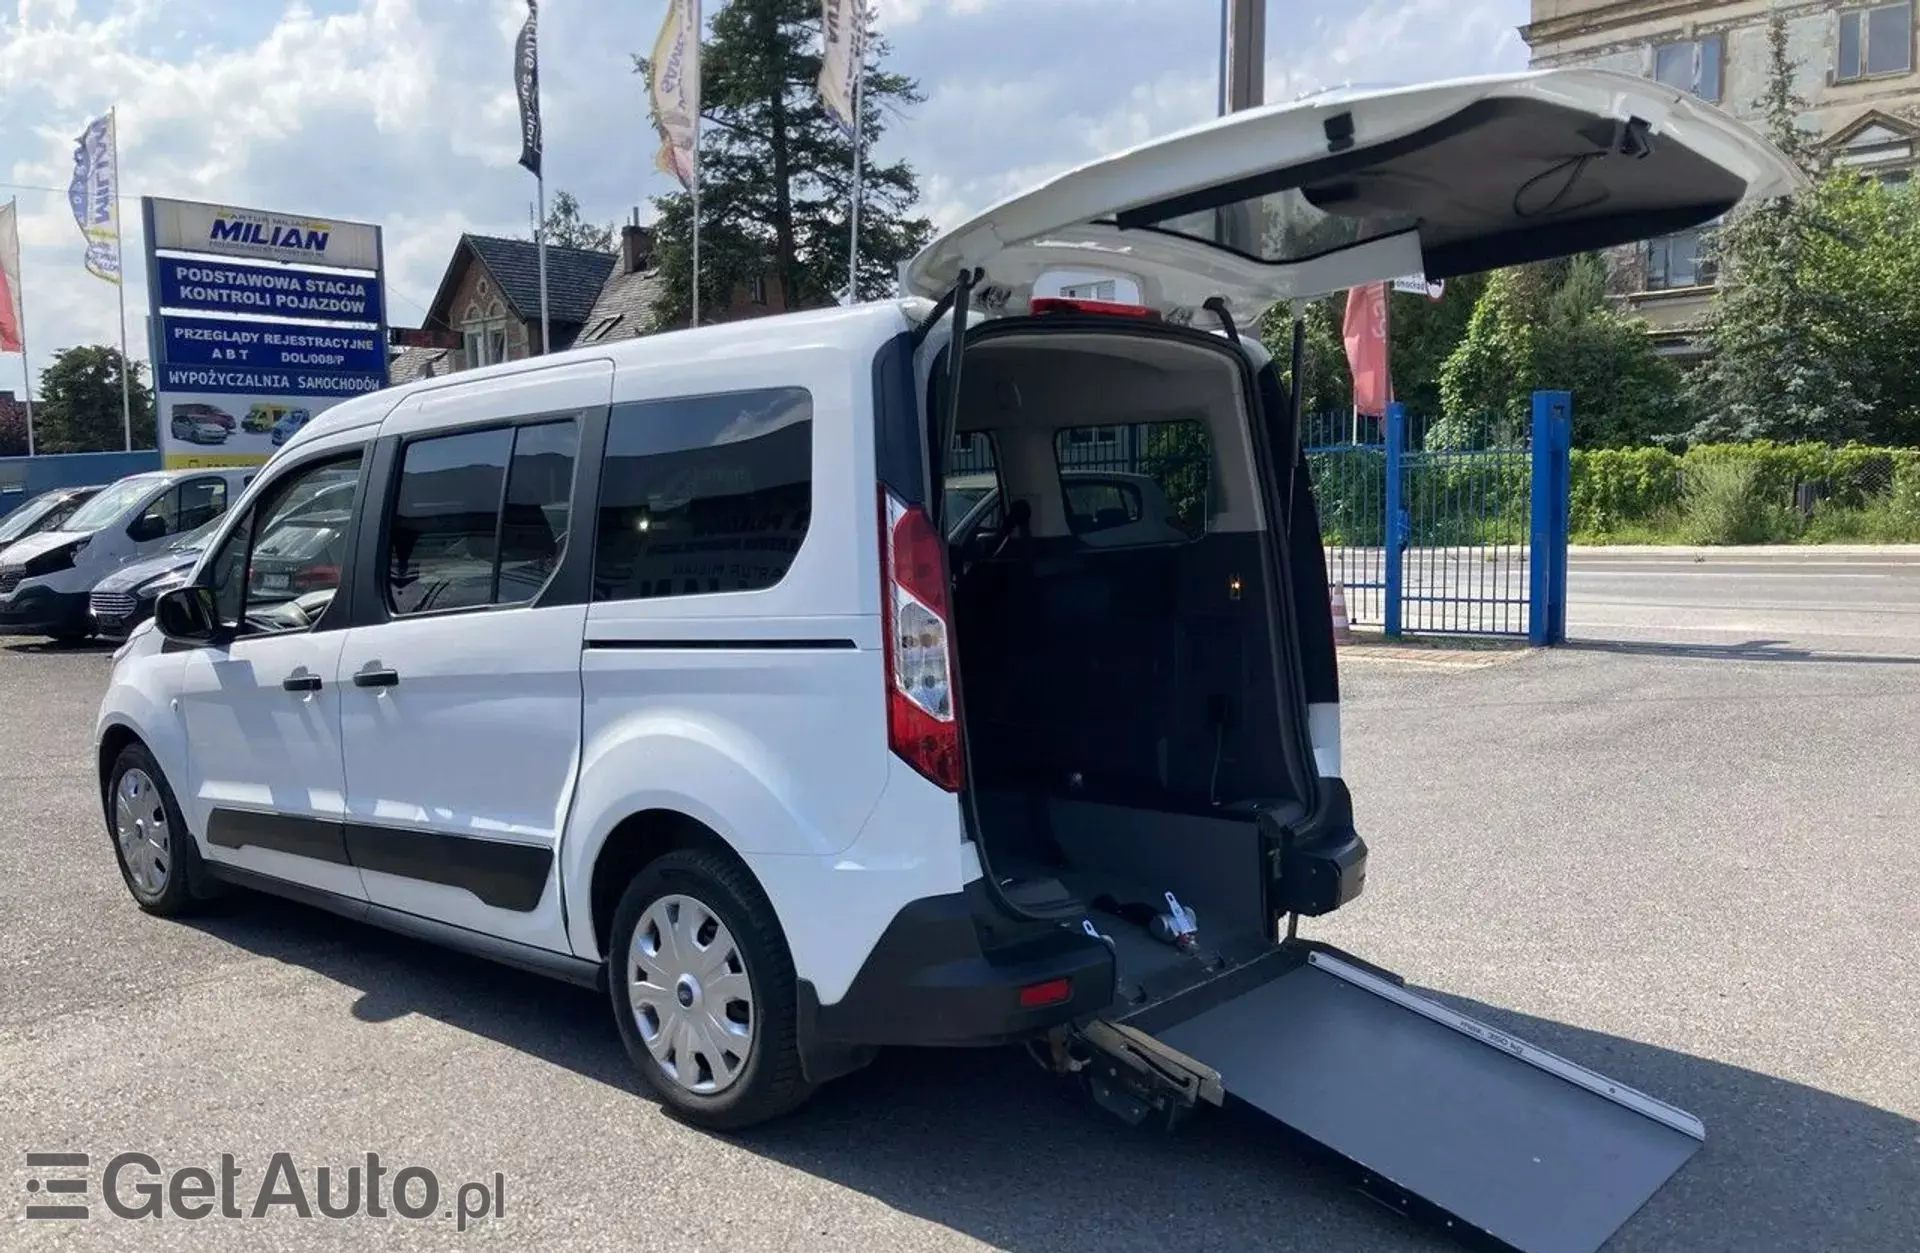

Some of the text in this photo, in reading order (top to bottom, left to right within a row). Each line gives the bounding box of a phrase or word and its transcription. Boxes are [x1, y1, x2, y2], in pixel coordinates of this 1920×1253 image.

[210, 218, 329, 251] MILIAN
[176, 266, 366, 297] PODSTAWOWA STACJA
[180, 285, 366, 314] KONTROLI POJAZDÓW
[174, 327, 374, 351] PRZEGLĄDY REJESTRACYJNE
[212, 348, 223, 360] A
[226, 349, 236, 360] B
[239, 350, 250, 360] T
[169, 368, 380, 392] WYPOŻYCZALNIA SAMOCHODÓW
